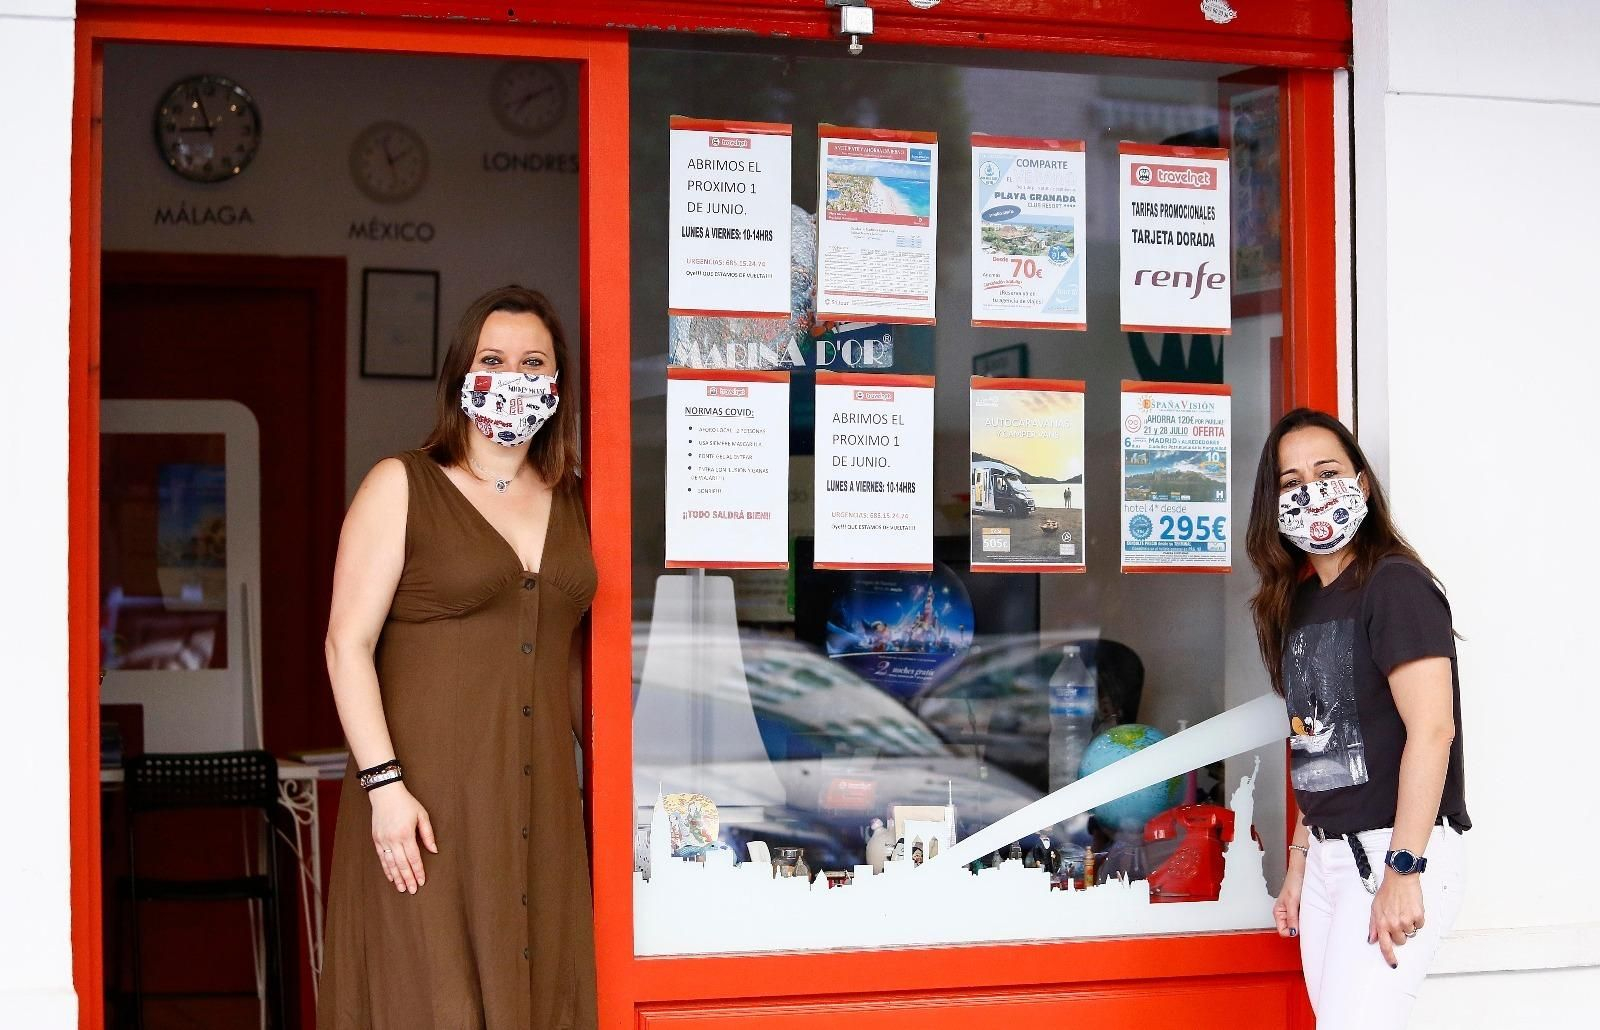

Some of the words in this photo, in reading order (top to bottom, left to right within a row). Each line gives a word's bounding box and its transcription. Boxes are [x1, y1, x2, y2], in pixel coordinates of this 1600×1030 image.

[482, 152, 579, 173] LONDRES
[687, 158, 745, 172] ABRIMOS
[748, 161, 762, 173] EL
[1016, 159, 1069, 170] COMPARTE
[1157, 168, 1211, 187] travelnet
[687, 180, 746, 194] PROXIMO
[750, 183, 757, 194] 1
[994, 191, 1027, 201] PLAYA
[1029, 193, 1077, 203] GRANADA
[153, 202, 254, 227] MÁLAGA
[687, 201, 703, 213] DE
[706, 202, 747, 216] JUNIO.
[1131, 201, 1159, 218] TARIFAS
[1160, 203, 1216, 221] PROMOCIONALES
[348, 216, 436, 242] MÉXICO
[681, 225, 704, 238] LUNES
[704, 226, 710, 239] A
[711, 227, 742, 240] VIERNES:
[742, 229, 773, 242] 10-14HRS
[1131, 228, 1174, 246] TARJETA
[1176, 231, 1216, 248] DORADA
[1010, 258, 1043, 279] 70€
[1134, 261, 1226, 300] renfe
[672, 335, 807, 370] MARINA
[684, 406, 723, 416] NORMAS
[725, 407, 754, 418] COVID:
[832, 412, 888, 425] ABRIMOS
[891, 414, 905, 426] EL
[1143, 426, 1152, 434] 21
[1160, 426, 1168, 435] 28
[1169, 426, 1189, 435] JULIO
[1192, 426, 1225, 437] OFERTA
[832, 434, 890, 447] PROXIMO
[893, 435, 900, 447] 1
[1124, 437, 1131, 448] 6
[832, 455, 848, 467] DE
[850, 456, 891, 468] JUNIO.
[1205, 451, 1220, 462] 10
[826, 479, 848, 492] LUNES
[849, 480, 855, 492] A
[855, 480, 885, 493] VIERNES:
[886, 481, 916, 494] 10-14HRS
[712, 509, 745, 520] SALDRÁ
[1124, 504, 1148, 513] hotel
[1160, 504, 1187, 513] desde
[1159, 514, 1227, 541] 295€
[874, 660, 890, 676] 2
